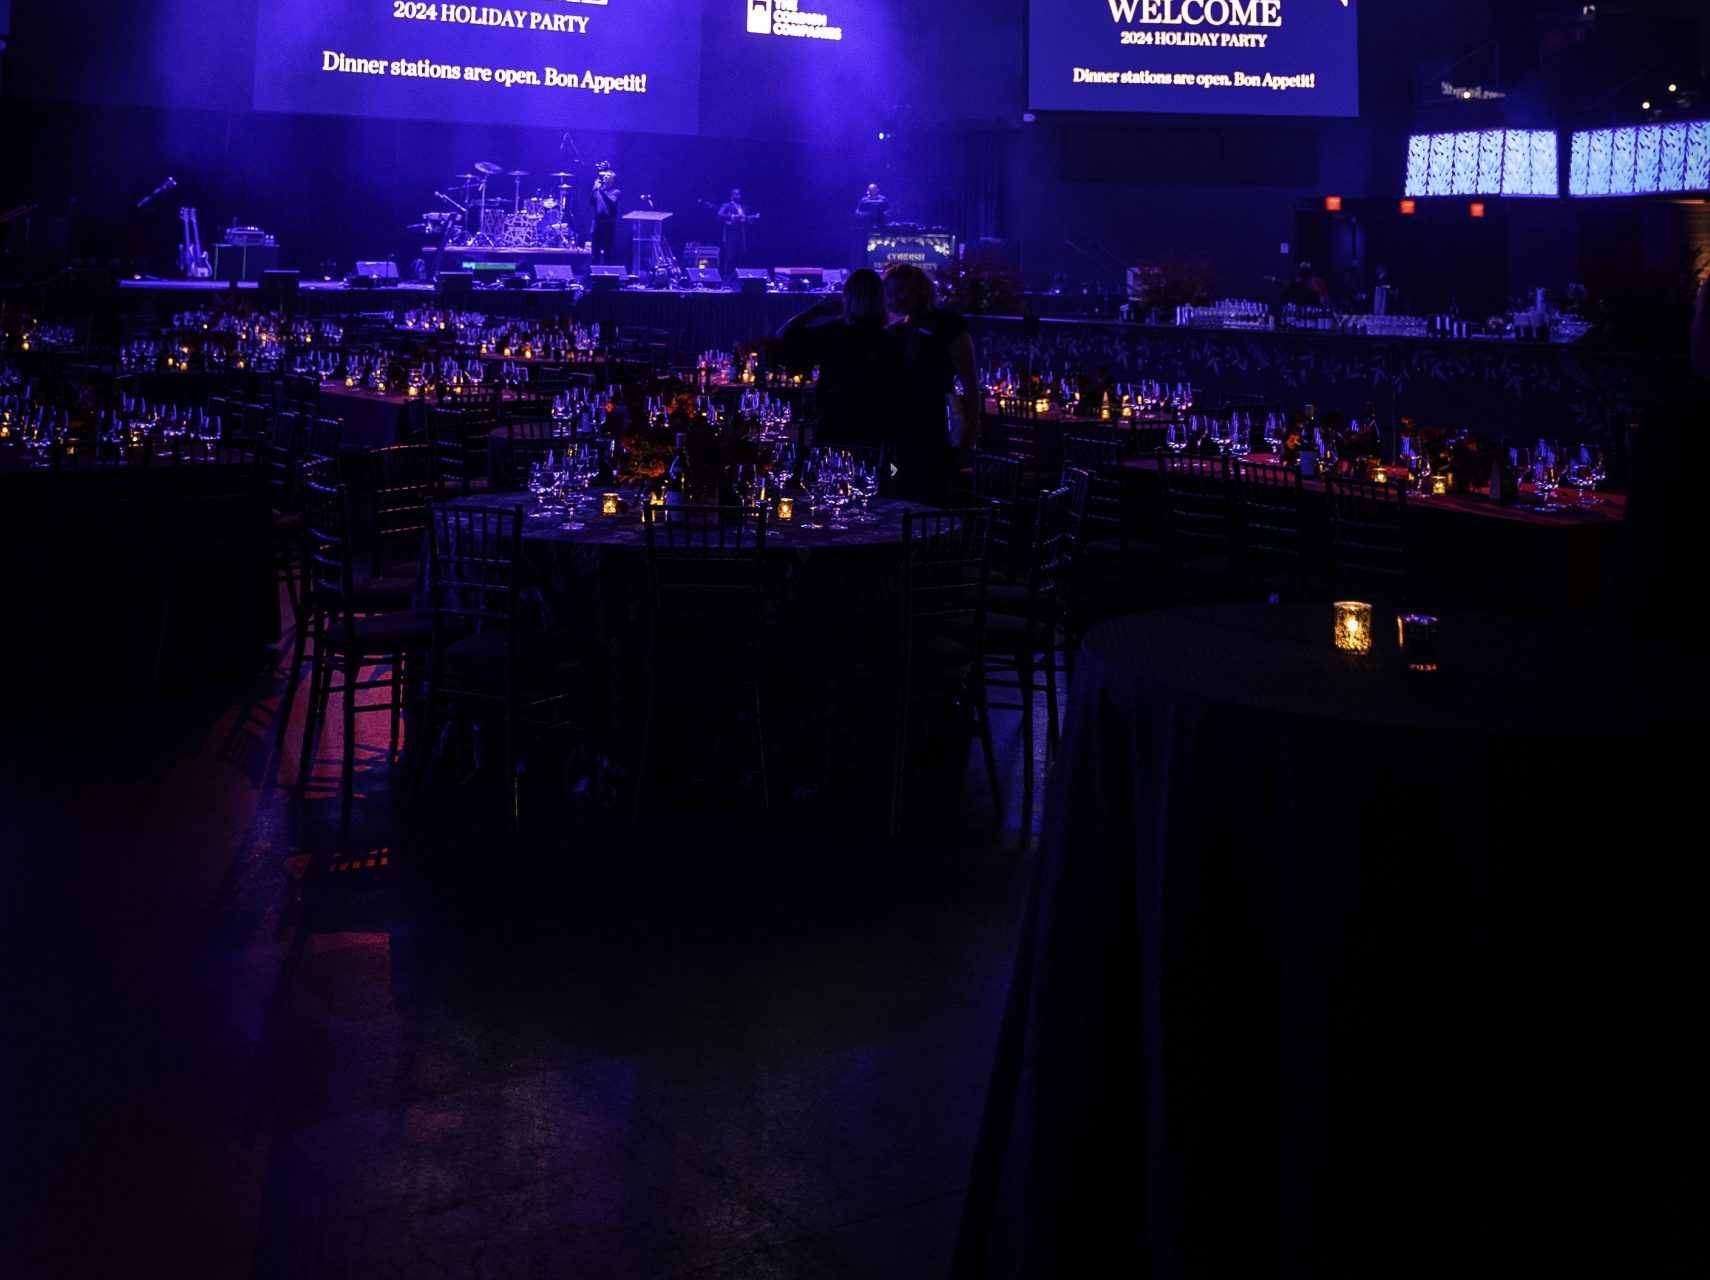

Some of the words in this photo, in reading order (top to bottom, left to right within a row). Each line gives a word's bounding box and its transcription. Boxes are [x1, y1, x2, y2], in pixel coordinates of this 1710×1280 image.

[393, 0, 439, 21] 2024
[440, 4, 527, 29] HOLIDAY
[529, 11, 590, 34] PARTY
[1120, 31, 1154, 45] 2024
[1154, 31, 1220, 47] HOLIDAY
[1220, 33, 1268, 48] PARTY
[322, 50, 389, 75] Dinner
[390, 59, 461, 81] stations
[463, 66, 493, 82] are
[494, 68, 541, 88] open.
[544, 66, 579, 89] Bon
[580, 70, 647, 94] Appetit!
[1072, 67, 1121, 84] Dinner
[1120, 70, 1172, 85] stations
[1173, 73, 1196, 86] are
[1196, 74, 1232, 89] open.
[1233, 71, 1262, 87] Bon
[1262, 72, 1315, 90] Appetit!
